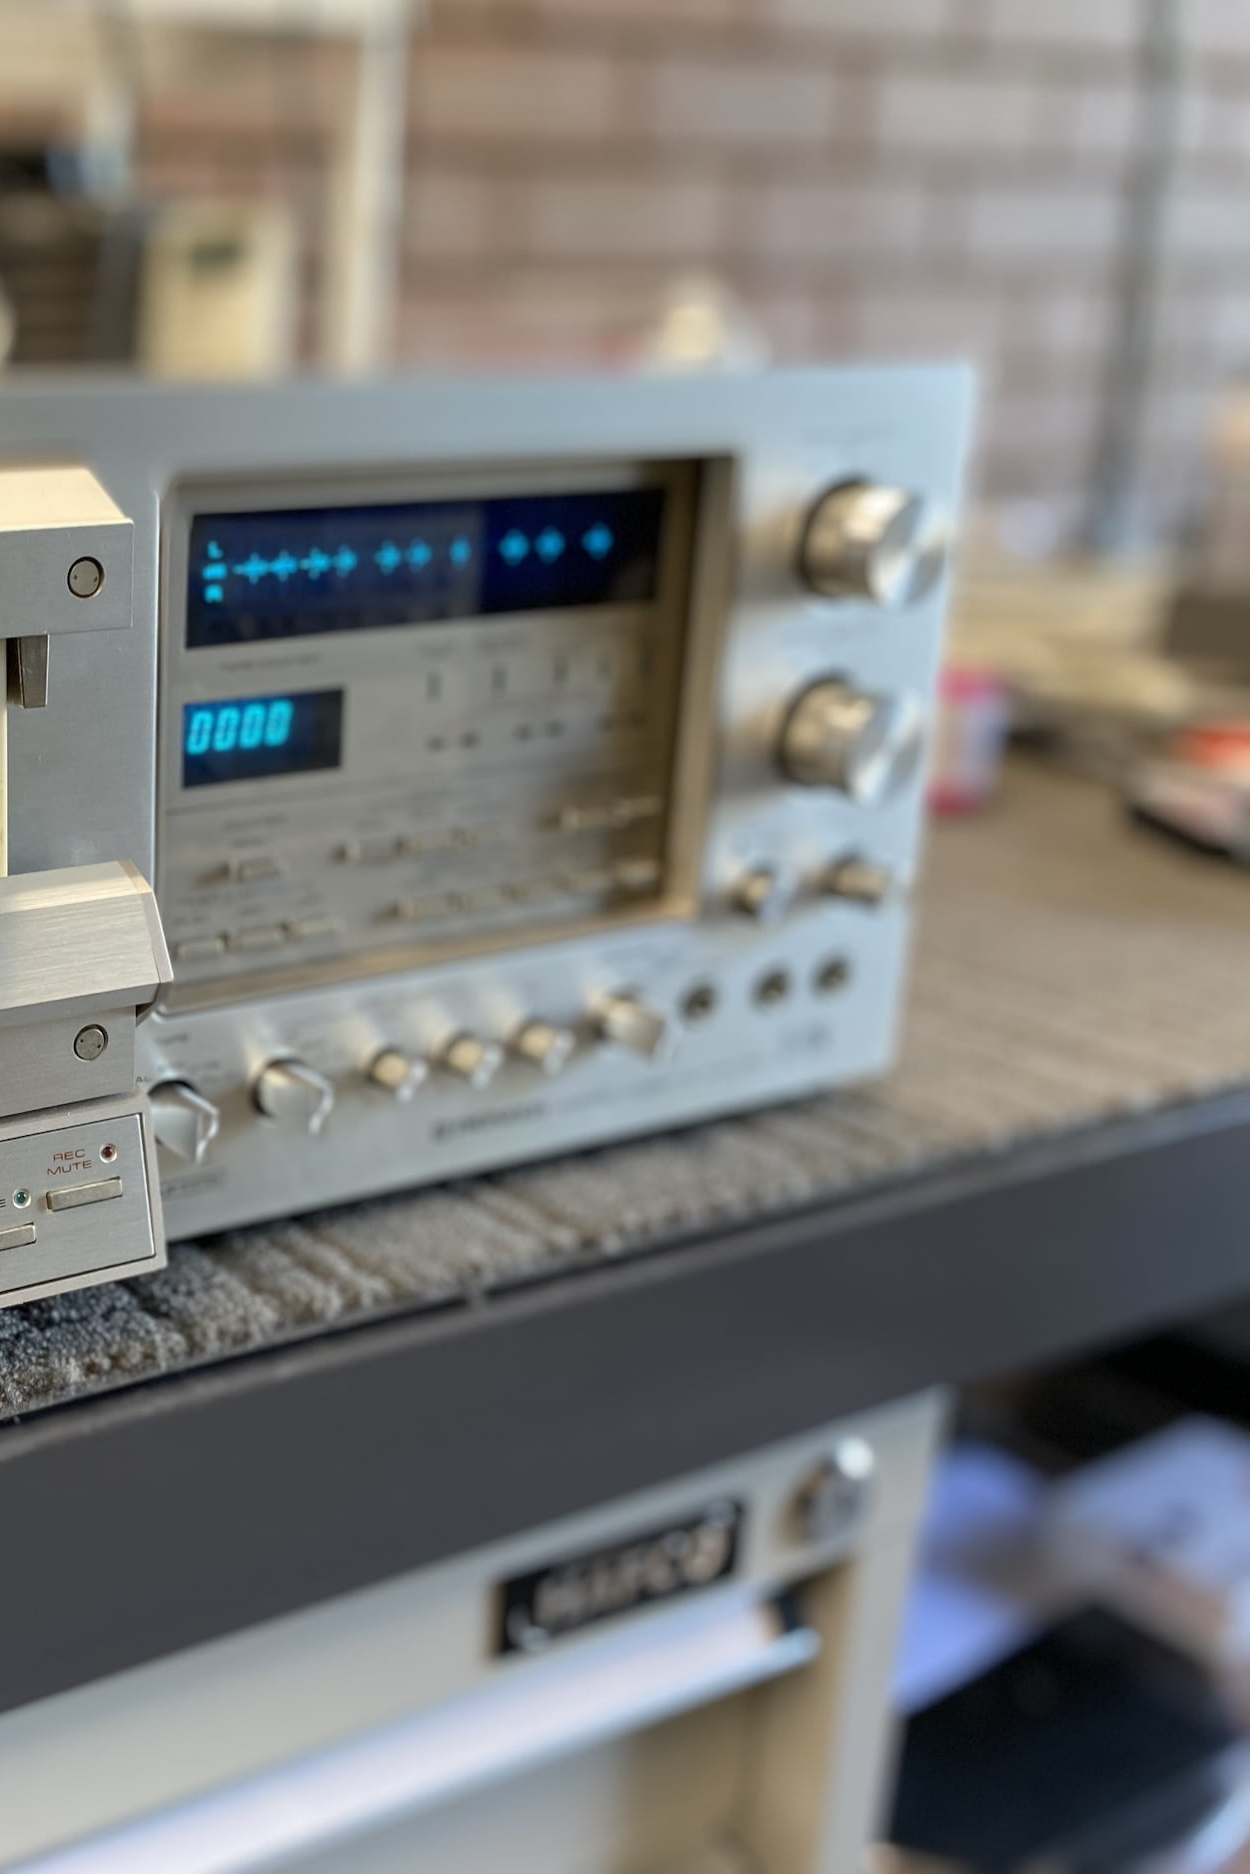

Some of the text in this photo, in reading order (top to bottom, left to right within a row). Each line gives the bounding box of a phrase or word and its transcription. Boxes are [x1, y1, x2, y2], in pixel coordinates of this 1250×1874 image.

[186, 699, 293, 755] 0000
[53, 1149, 86, 1163] REC
[46, 1159, 93, 1176] MUTE
